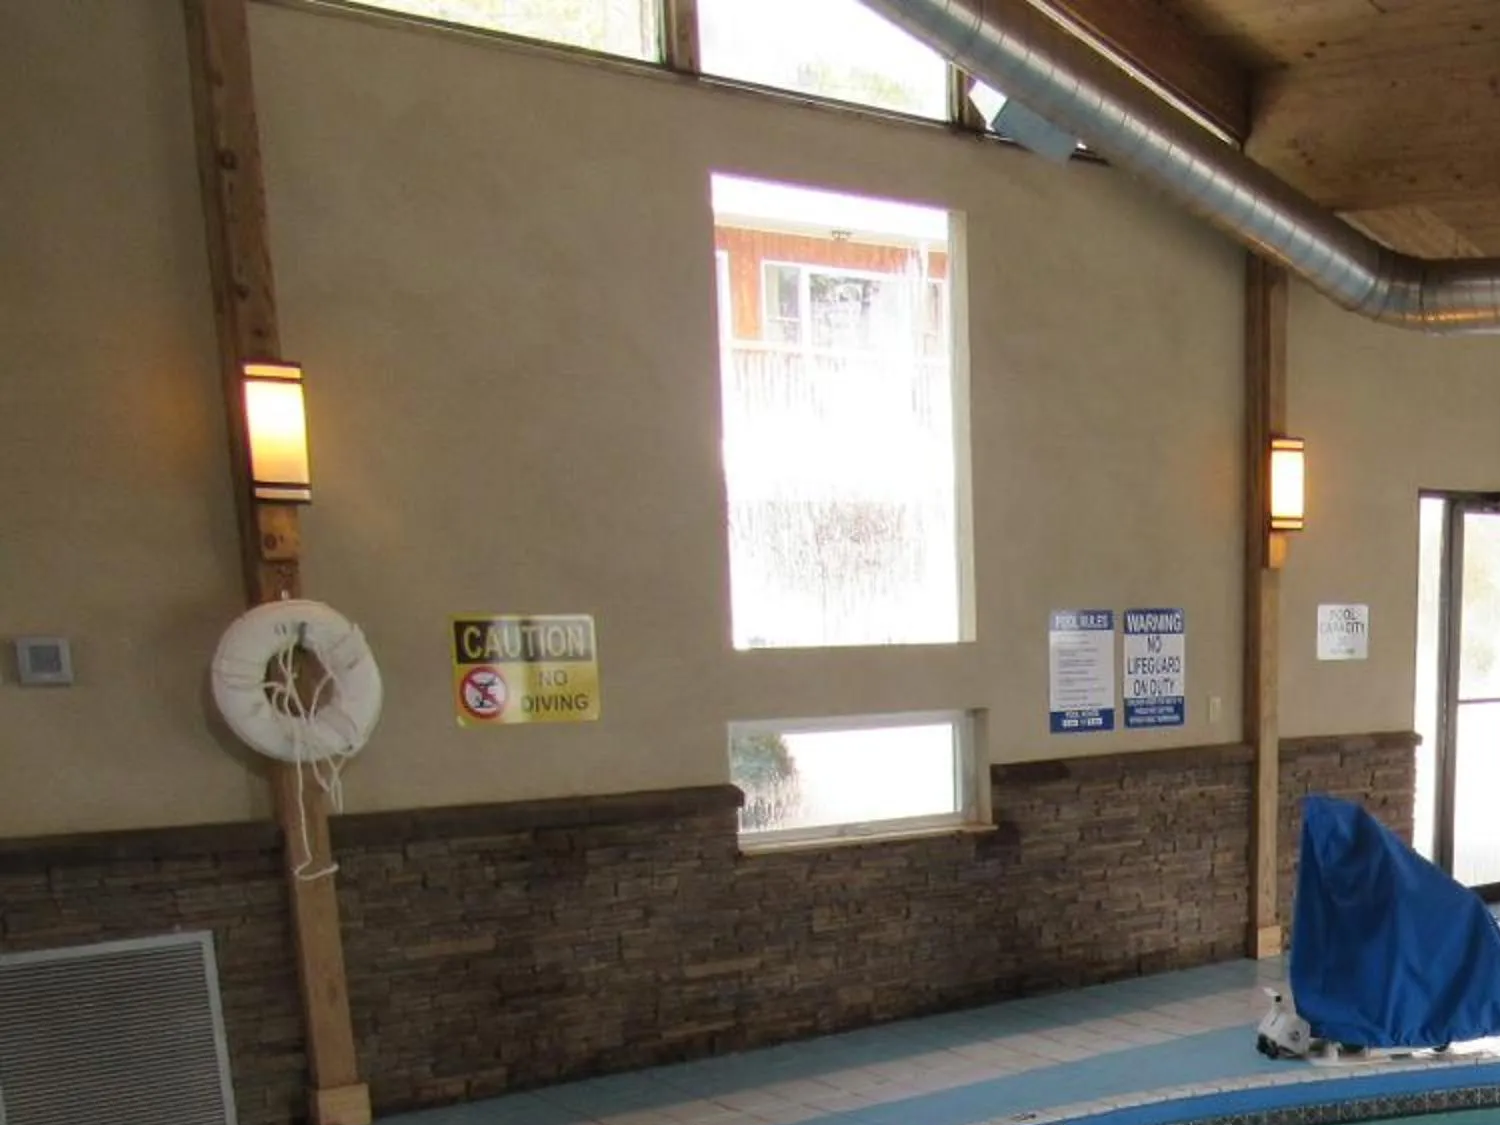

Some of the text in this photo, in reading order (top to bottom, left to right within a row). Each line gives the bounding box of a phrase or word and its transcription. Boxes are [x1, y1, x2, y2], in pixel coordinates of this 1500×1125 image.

[1127, 613, 1182, 633] WARNING
[463, 624, 585, 659] CAUTION
[1147, 636, 1163, 654] NO
[1127, 656, 1182, 676] LIFEGUARD
[538, 669, 568, 687] NO
[1133, 677, 1175, 697] ON DUTY
[520, 694, 588, 713] DIVING
